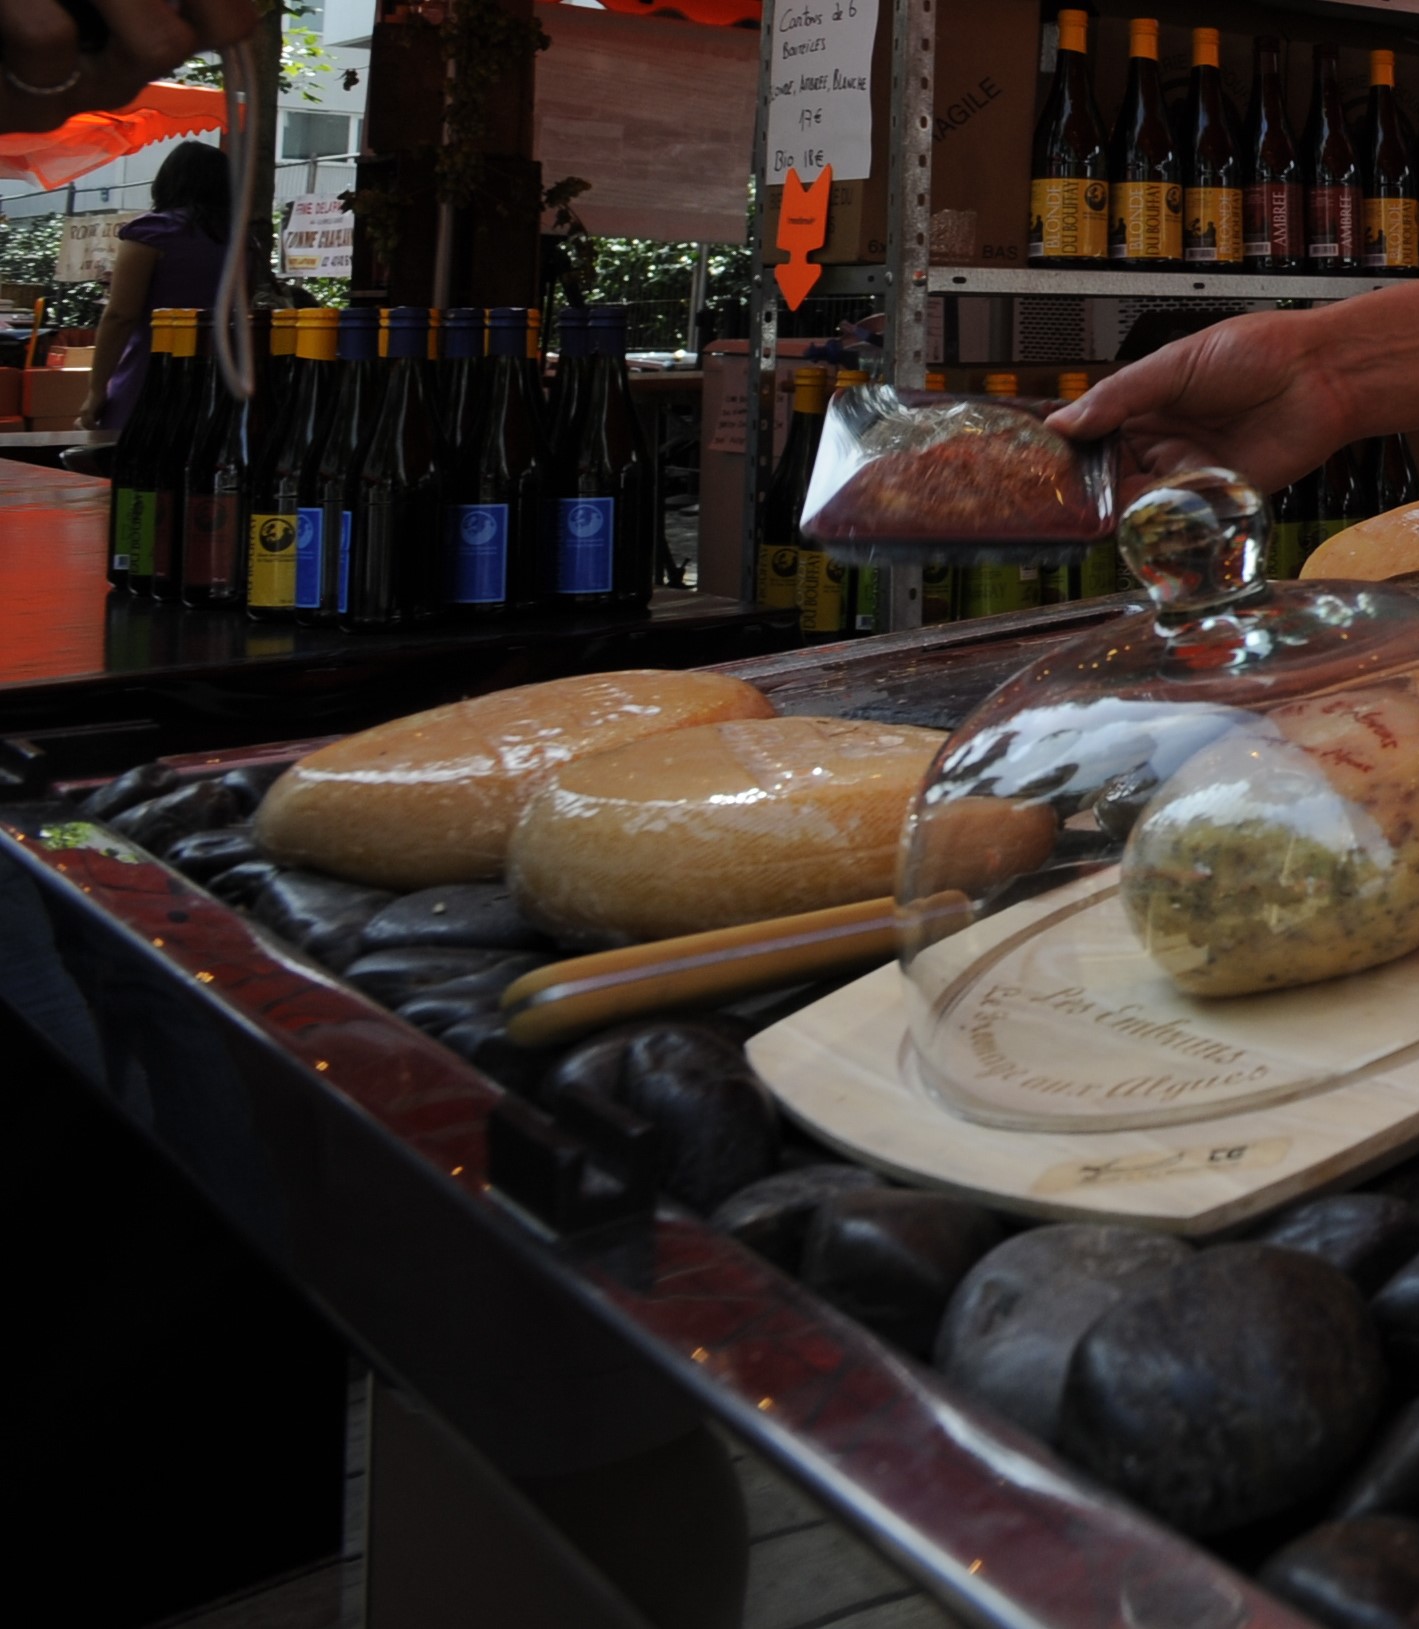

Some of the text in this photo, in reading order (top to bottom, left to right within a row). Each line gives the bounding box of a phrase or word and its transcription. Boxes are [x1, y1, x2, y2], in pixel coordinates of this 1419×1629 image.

[934, 77, 1002, 142] AGILE
[1045, 188, 1062, 249] BLONDE
[1062, 235, 1078, 254] DU
[1129, 188, 1144, 250] BLONDE
[982, 245, 1018, 260] BAS
